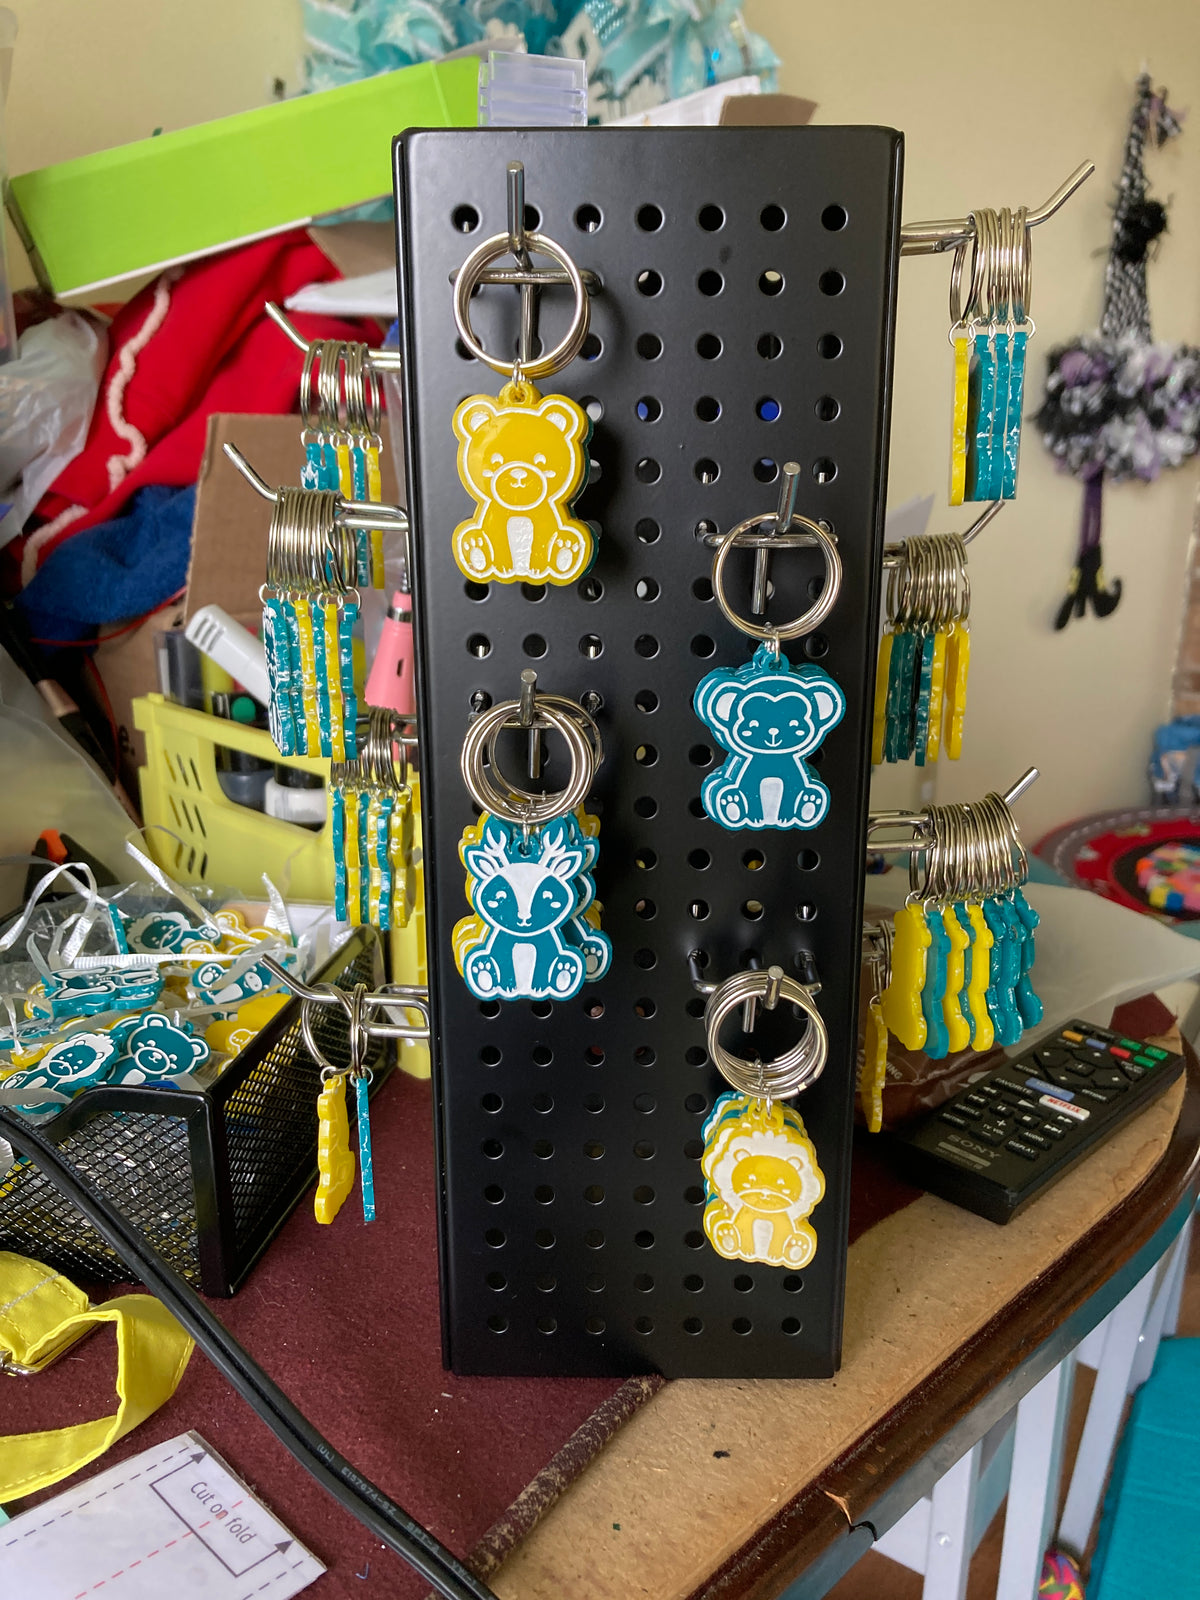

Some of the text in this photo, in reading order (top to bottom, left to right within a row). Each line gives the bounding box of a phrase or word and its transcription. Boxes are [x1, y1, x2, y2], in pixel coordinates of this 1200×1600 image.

[1048, 1097, 1082, 1114] NETFLIX
[1023, 1131, 1045, 1142] AUDIO
[947, 1134, 1000, 1159] SONY
[1008, 1140, 1036, 1155] DISPLAY
[190, 1481, 258, 1544] Cut on fold
